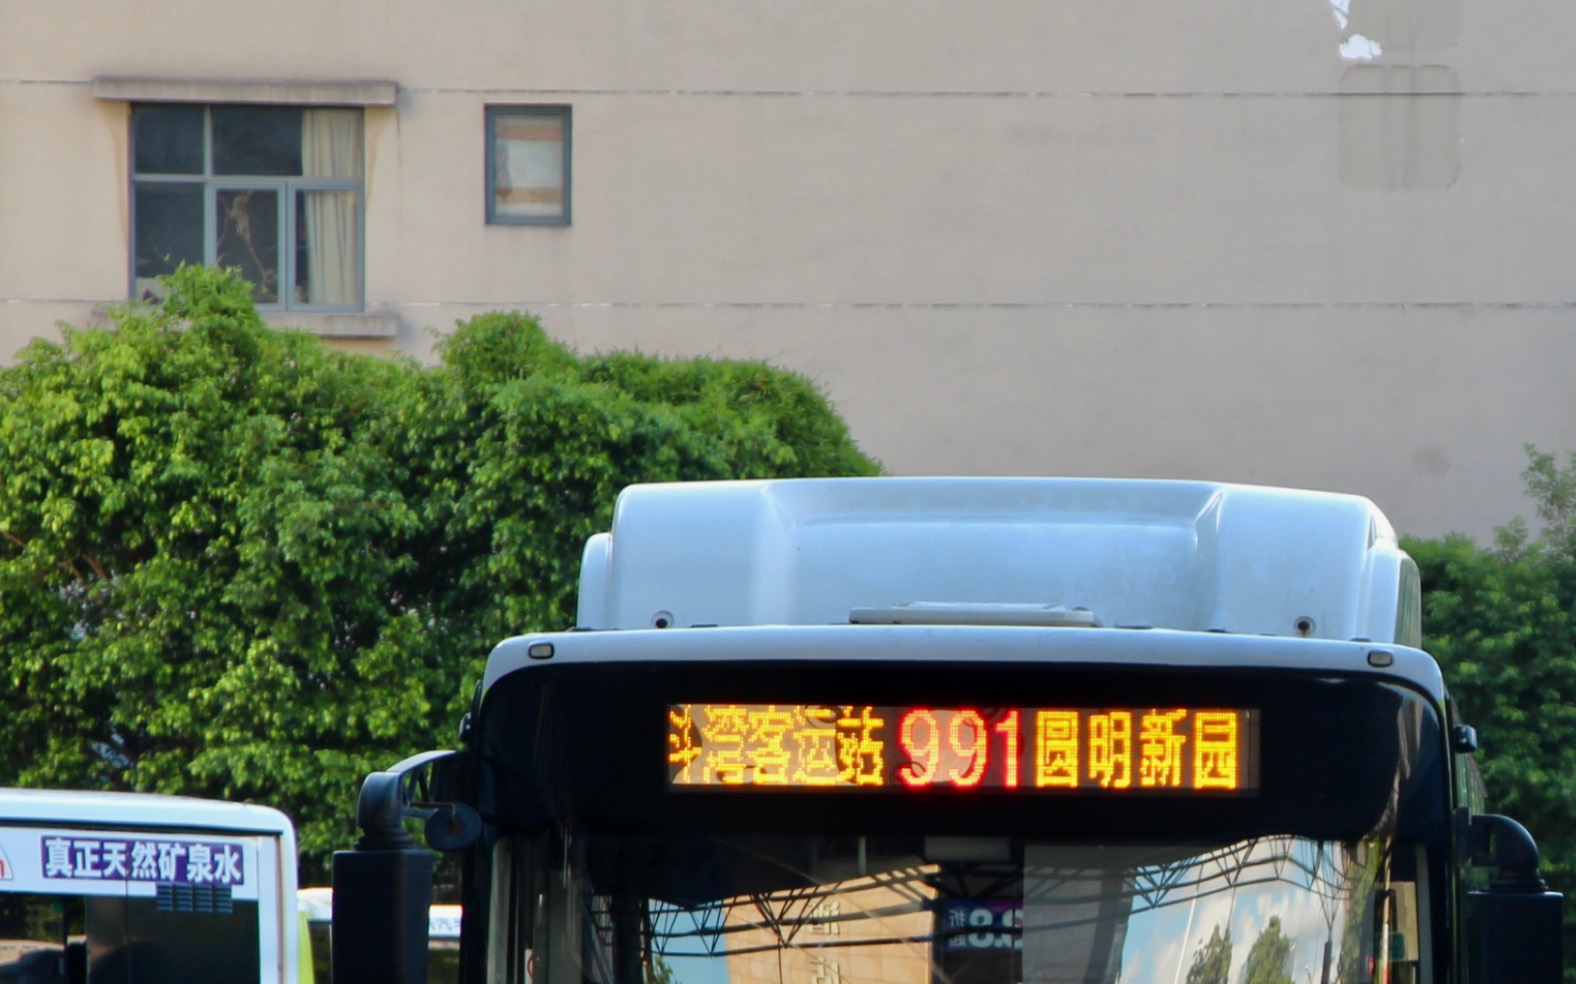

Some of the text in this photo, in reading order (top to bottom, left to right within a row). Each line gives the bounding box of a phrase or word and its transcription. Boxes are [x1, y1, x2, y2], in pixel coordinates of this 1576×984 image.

[899, 709, 1022, 789] 991
[1035, 709, 1239, 788] 圆明新园
[44, 837, 243, 884] 真正天然矿泉水
